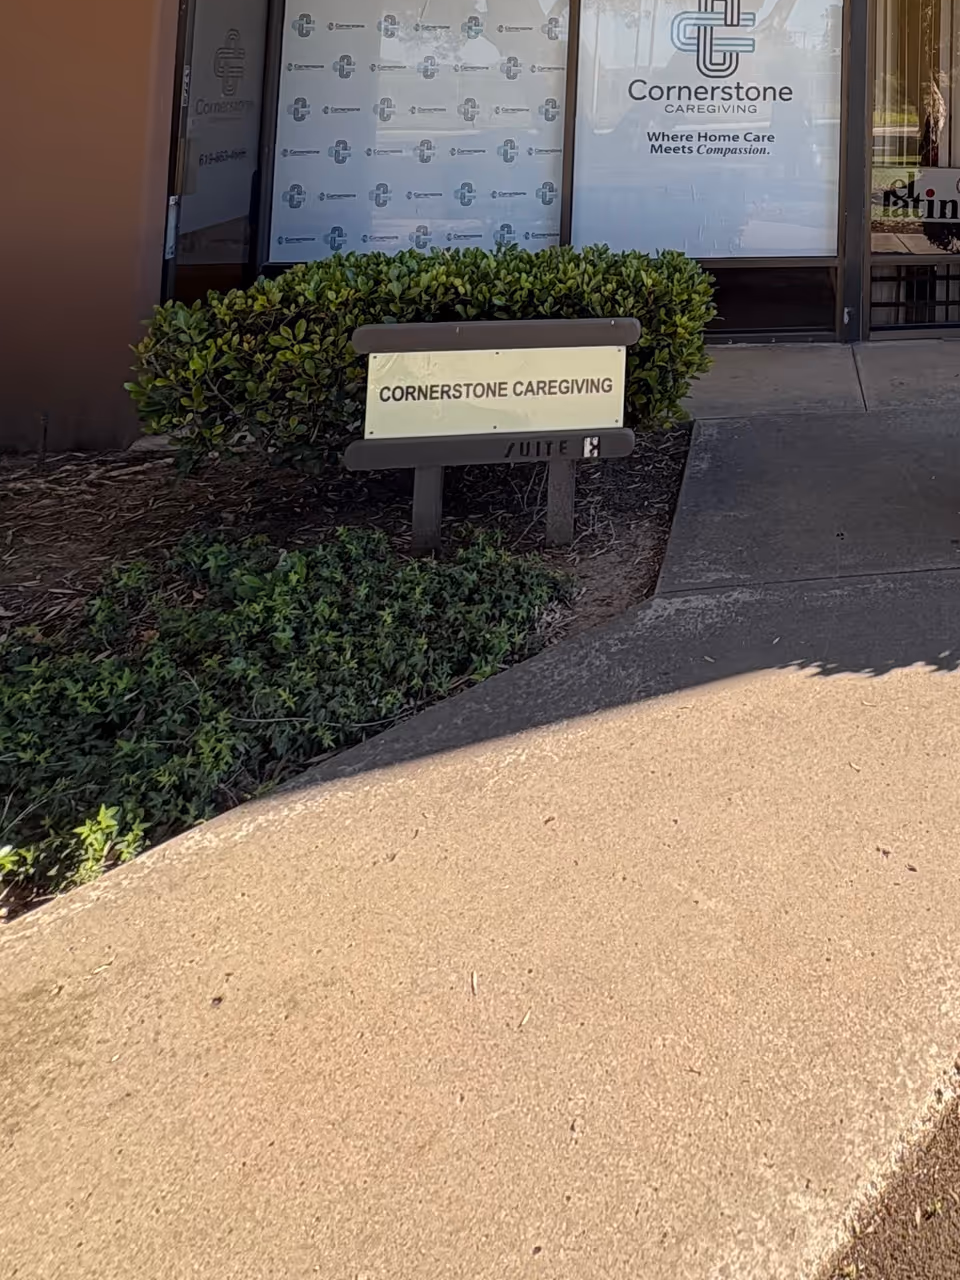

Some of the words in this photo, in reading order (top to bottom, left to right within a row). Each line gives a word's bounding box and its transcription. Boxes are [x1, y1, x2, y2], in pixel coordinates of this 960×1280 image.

[628, 79, 793, 101] Cornerstone
[664, 104, 757, 114] CAREGIVING
[647, 131, 694, 143] Where
[697, 131, 740, 143] Home
[743, 131, 776, 143] Care
[650, 144, 694, 155] Meets
[696, 144, 771, 158] Compassion.
[889, 171, 920, 200] el
[379, 381, 509, 403] CORNERSTONE
[512, 377, 614, 399] CAREGIVING
